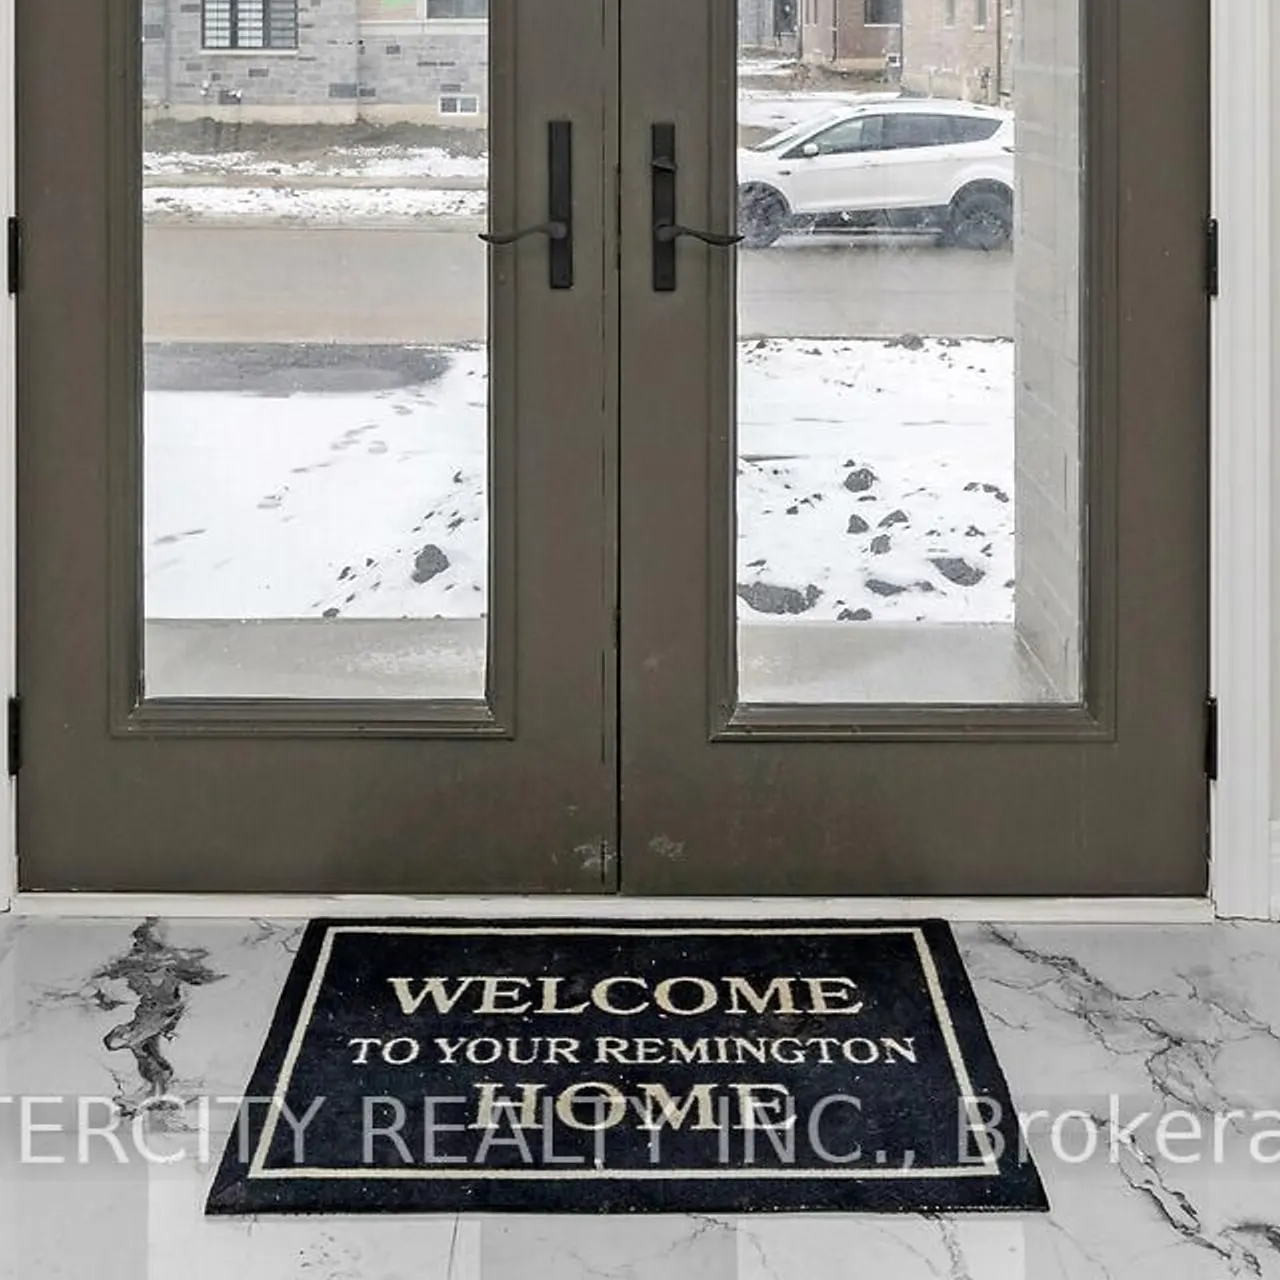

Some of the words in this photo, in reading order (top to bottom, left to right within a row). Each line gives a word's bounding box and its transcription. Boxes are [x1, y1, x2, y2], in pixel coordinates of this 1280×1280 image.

[387, 975, 863, 1015] WELCOME
[348, 1037, 420, 1064] TO
[434, 1037, 579, 1064] YOUR
[594, 1037, 917, 1064] REMINGTON
[467, 1081, 797, 1130] HOME
